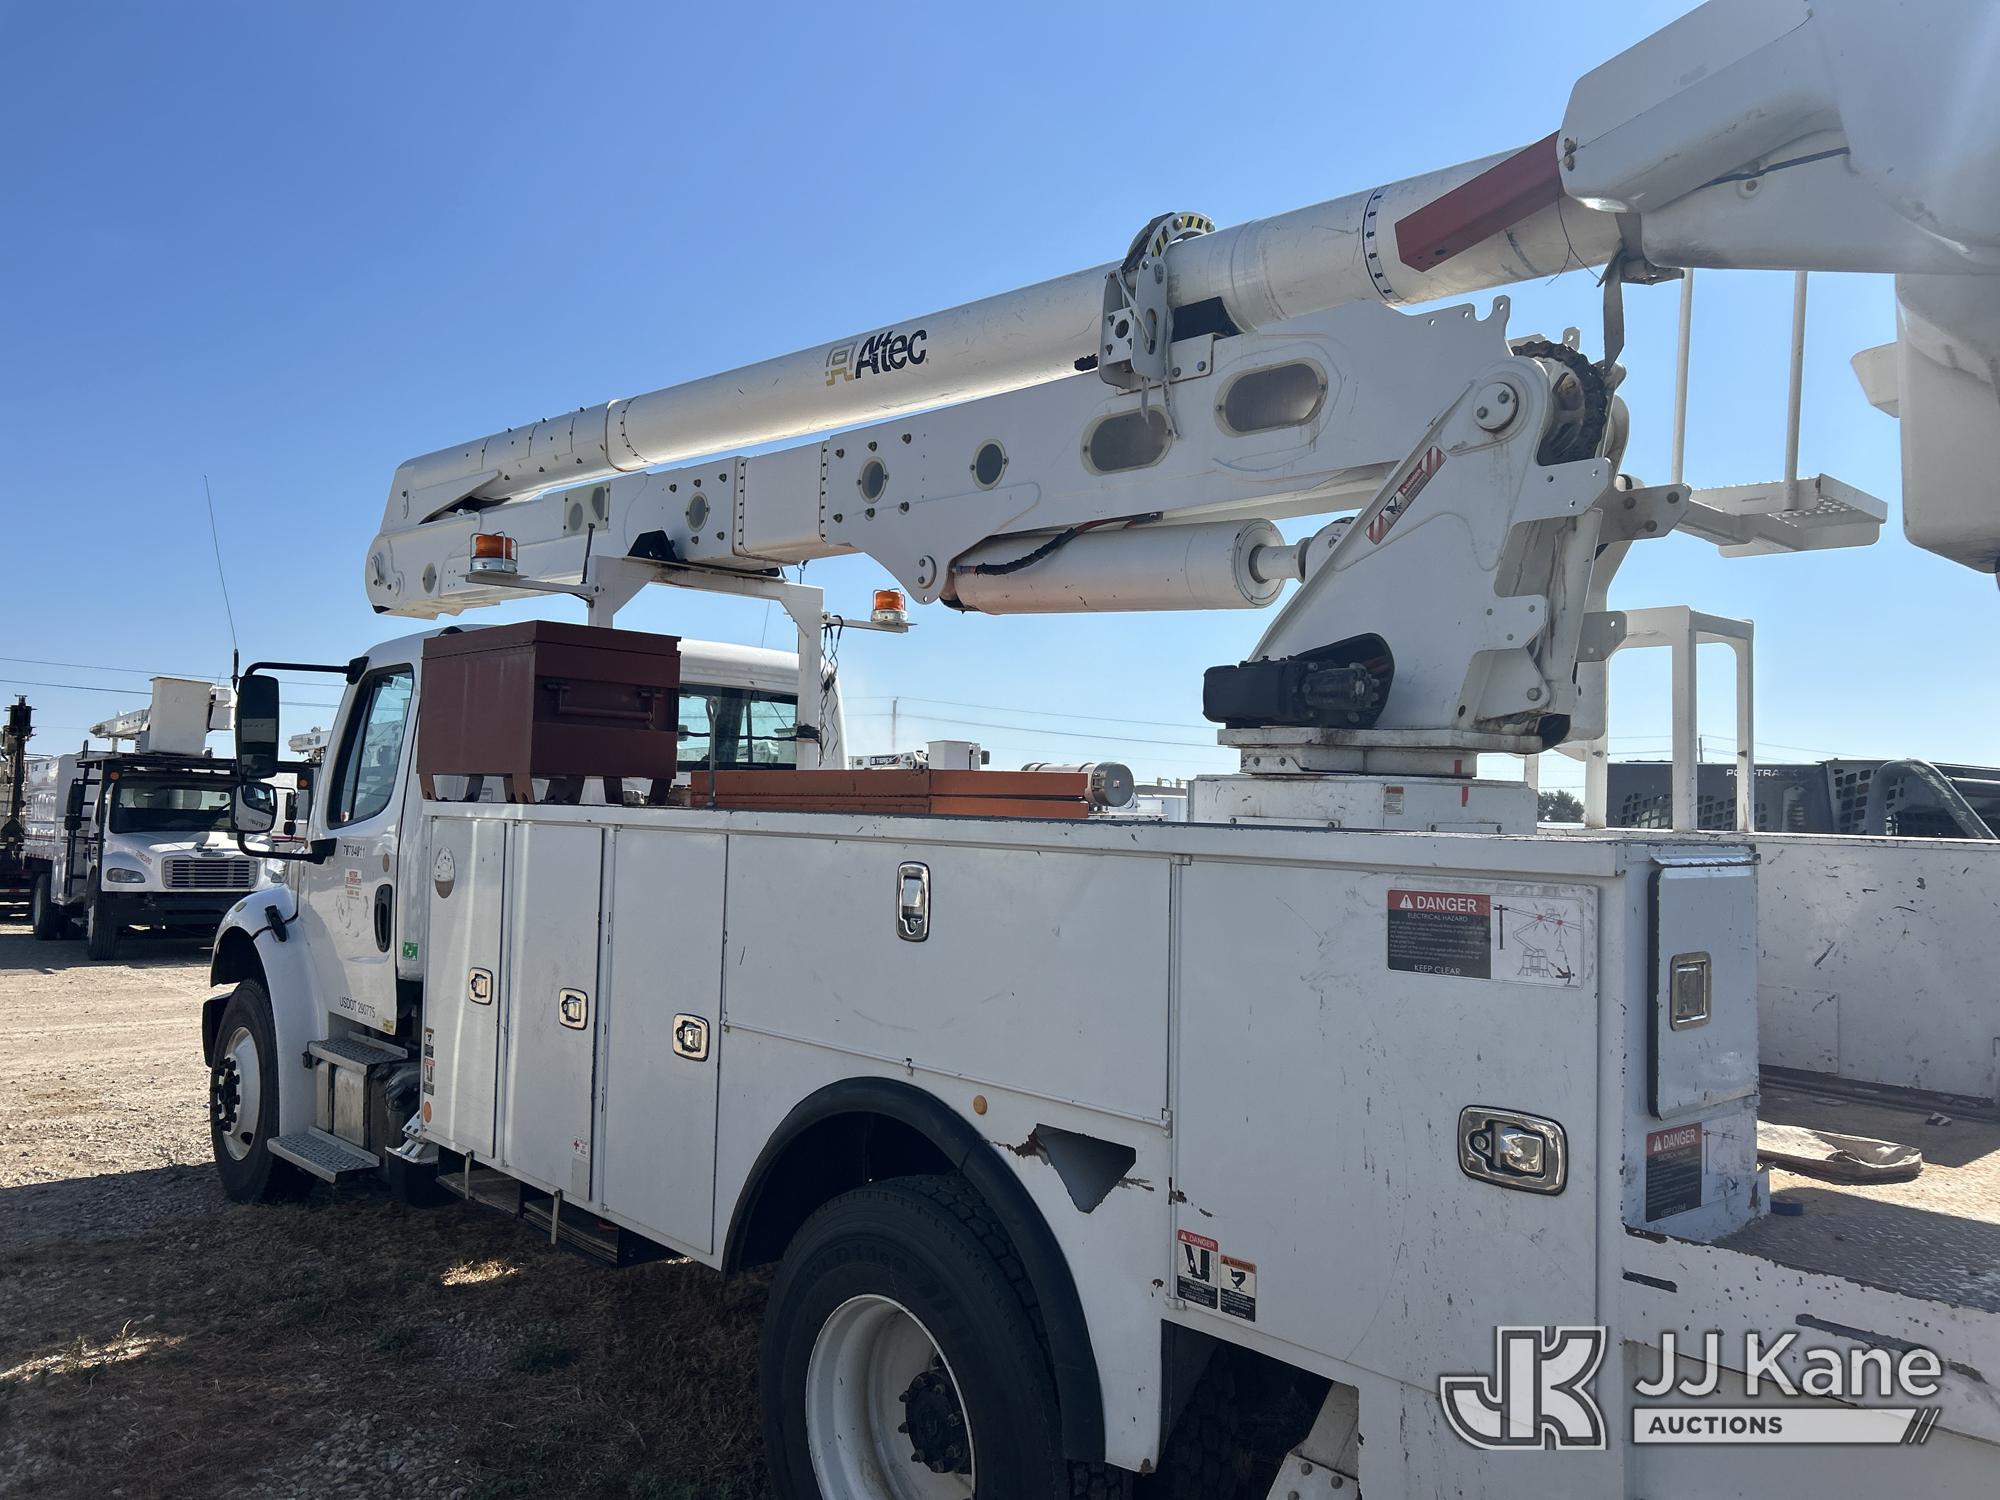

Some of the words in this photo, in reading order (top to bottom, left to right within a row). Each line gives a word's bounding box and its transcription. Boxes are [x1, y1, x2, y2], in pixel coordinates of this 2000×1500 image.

[855, 329, 927, 379] Altec
[1416, 896, 1477, 912] DANGER
[1407, 912, 1441, 920] ELECTRICAL
[1414, 964, 1433, 973] KEEP
[1434, 966, 1461, 975] CLEAR
[339, 995, 357, 1012] USDOT
[1663, 1128, 1696, 1149] DANGER
[1189, 1235, 1215, 1249] DANGER
